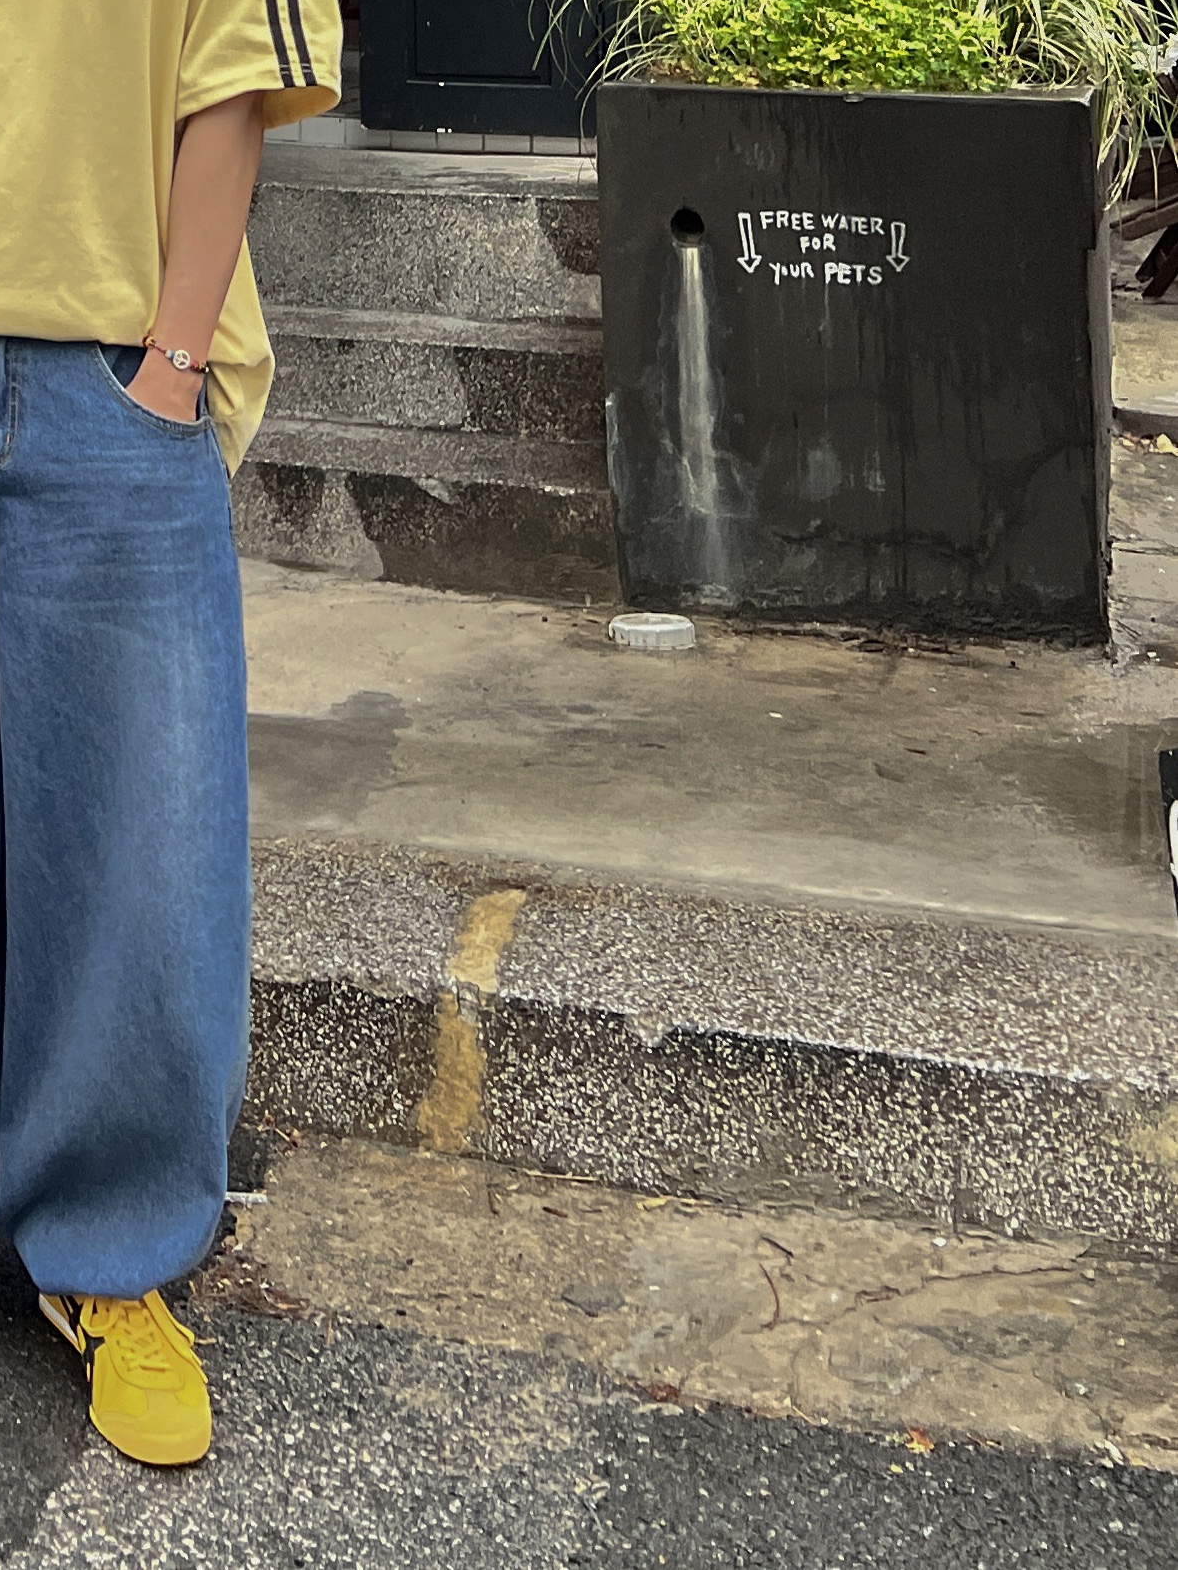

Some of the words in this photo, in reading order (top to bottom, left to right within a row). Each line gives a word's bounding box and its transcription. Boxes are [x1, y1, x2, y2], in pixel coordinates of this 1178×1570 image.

[759, 210, 815, 231] FREE
[821, 212, 886, 236] WATER
[799, 233, 836, 254] FOR
[824, 261, 883, 285] PETS
